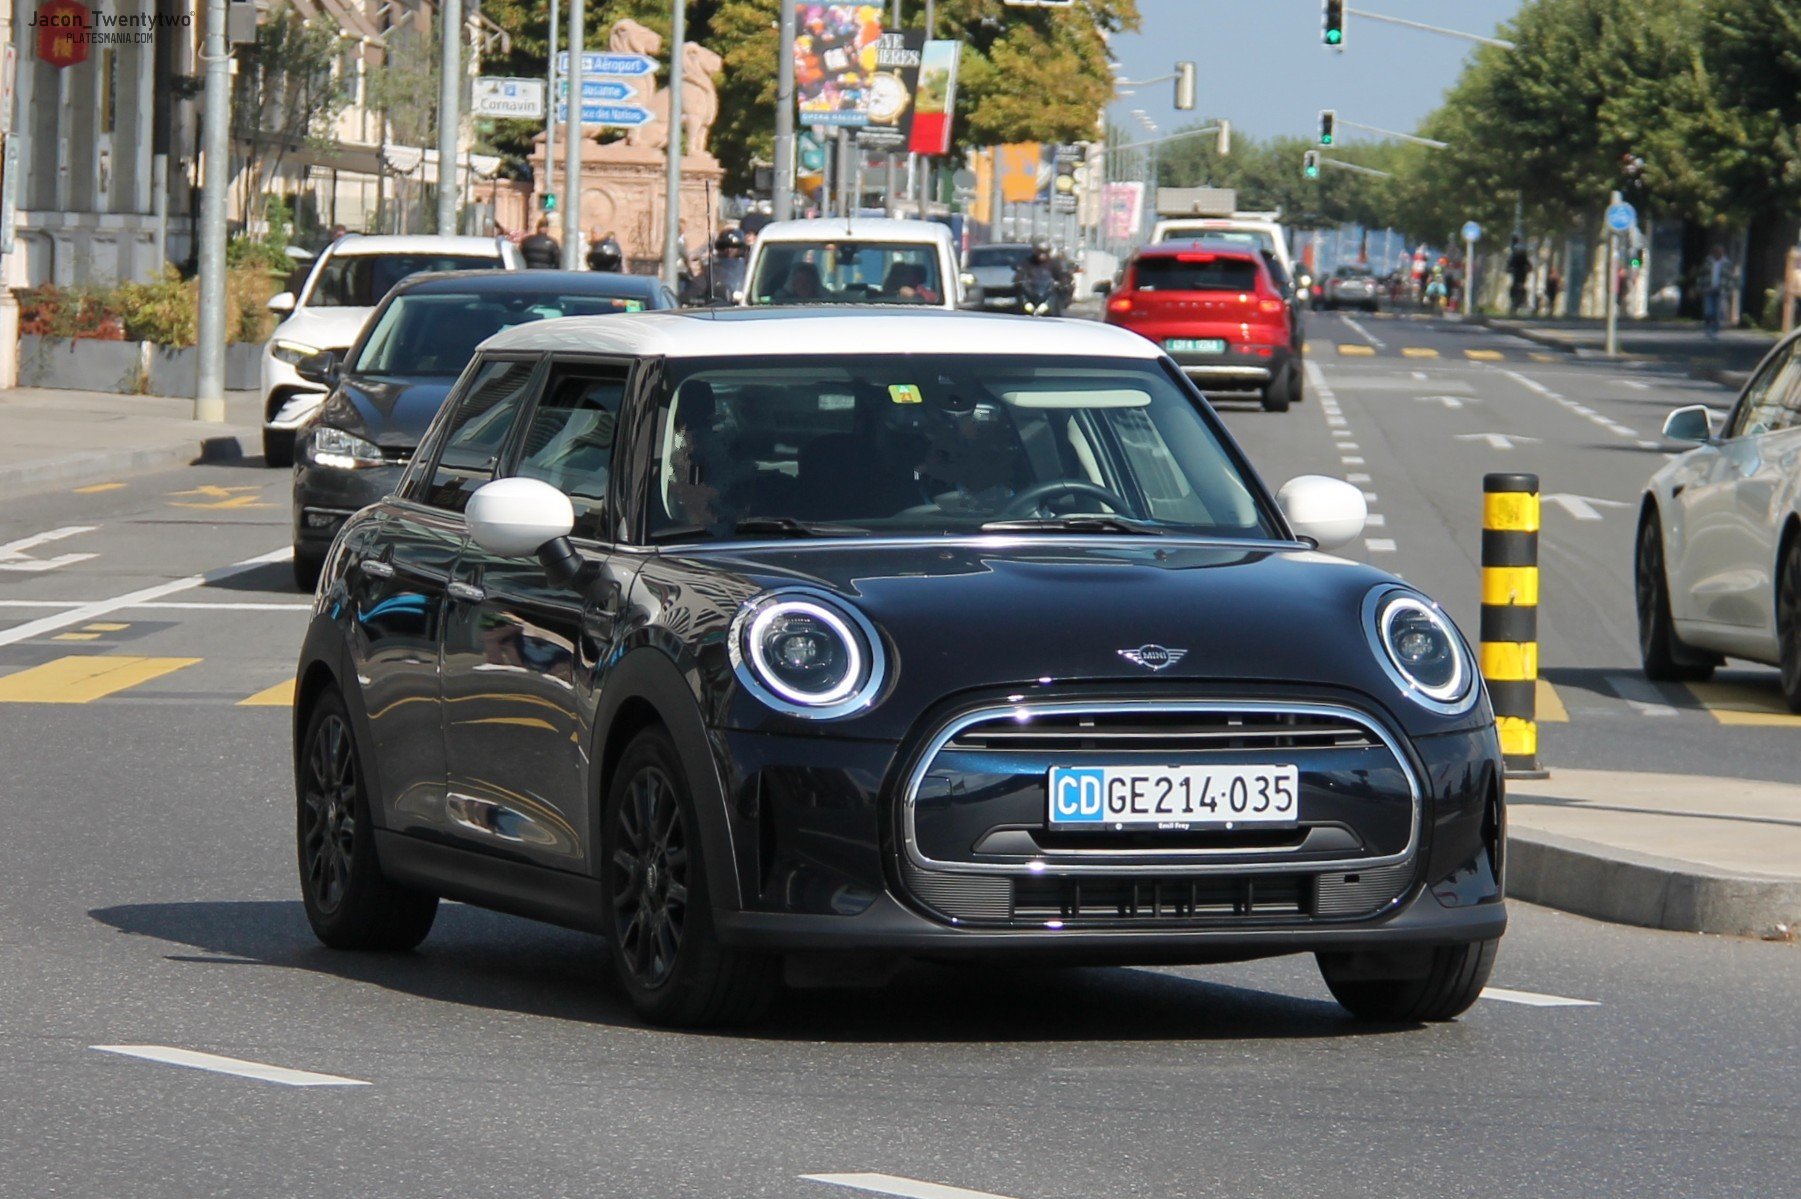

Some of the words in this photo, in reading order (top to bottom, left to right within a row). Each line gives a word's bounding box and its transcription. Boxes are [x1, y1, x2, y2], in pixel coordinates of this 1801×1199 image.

[595, 57, 643, 73] Aéroport
[582, 84, 620, 97] ausanne
[480, 97, 535, 111] Cornavin
[1142, 651, 1167, 660] MINI
[1057, 775, 1101, 815] CD
[1175, 823, 1190, 831] Frey
